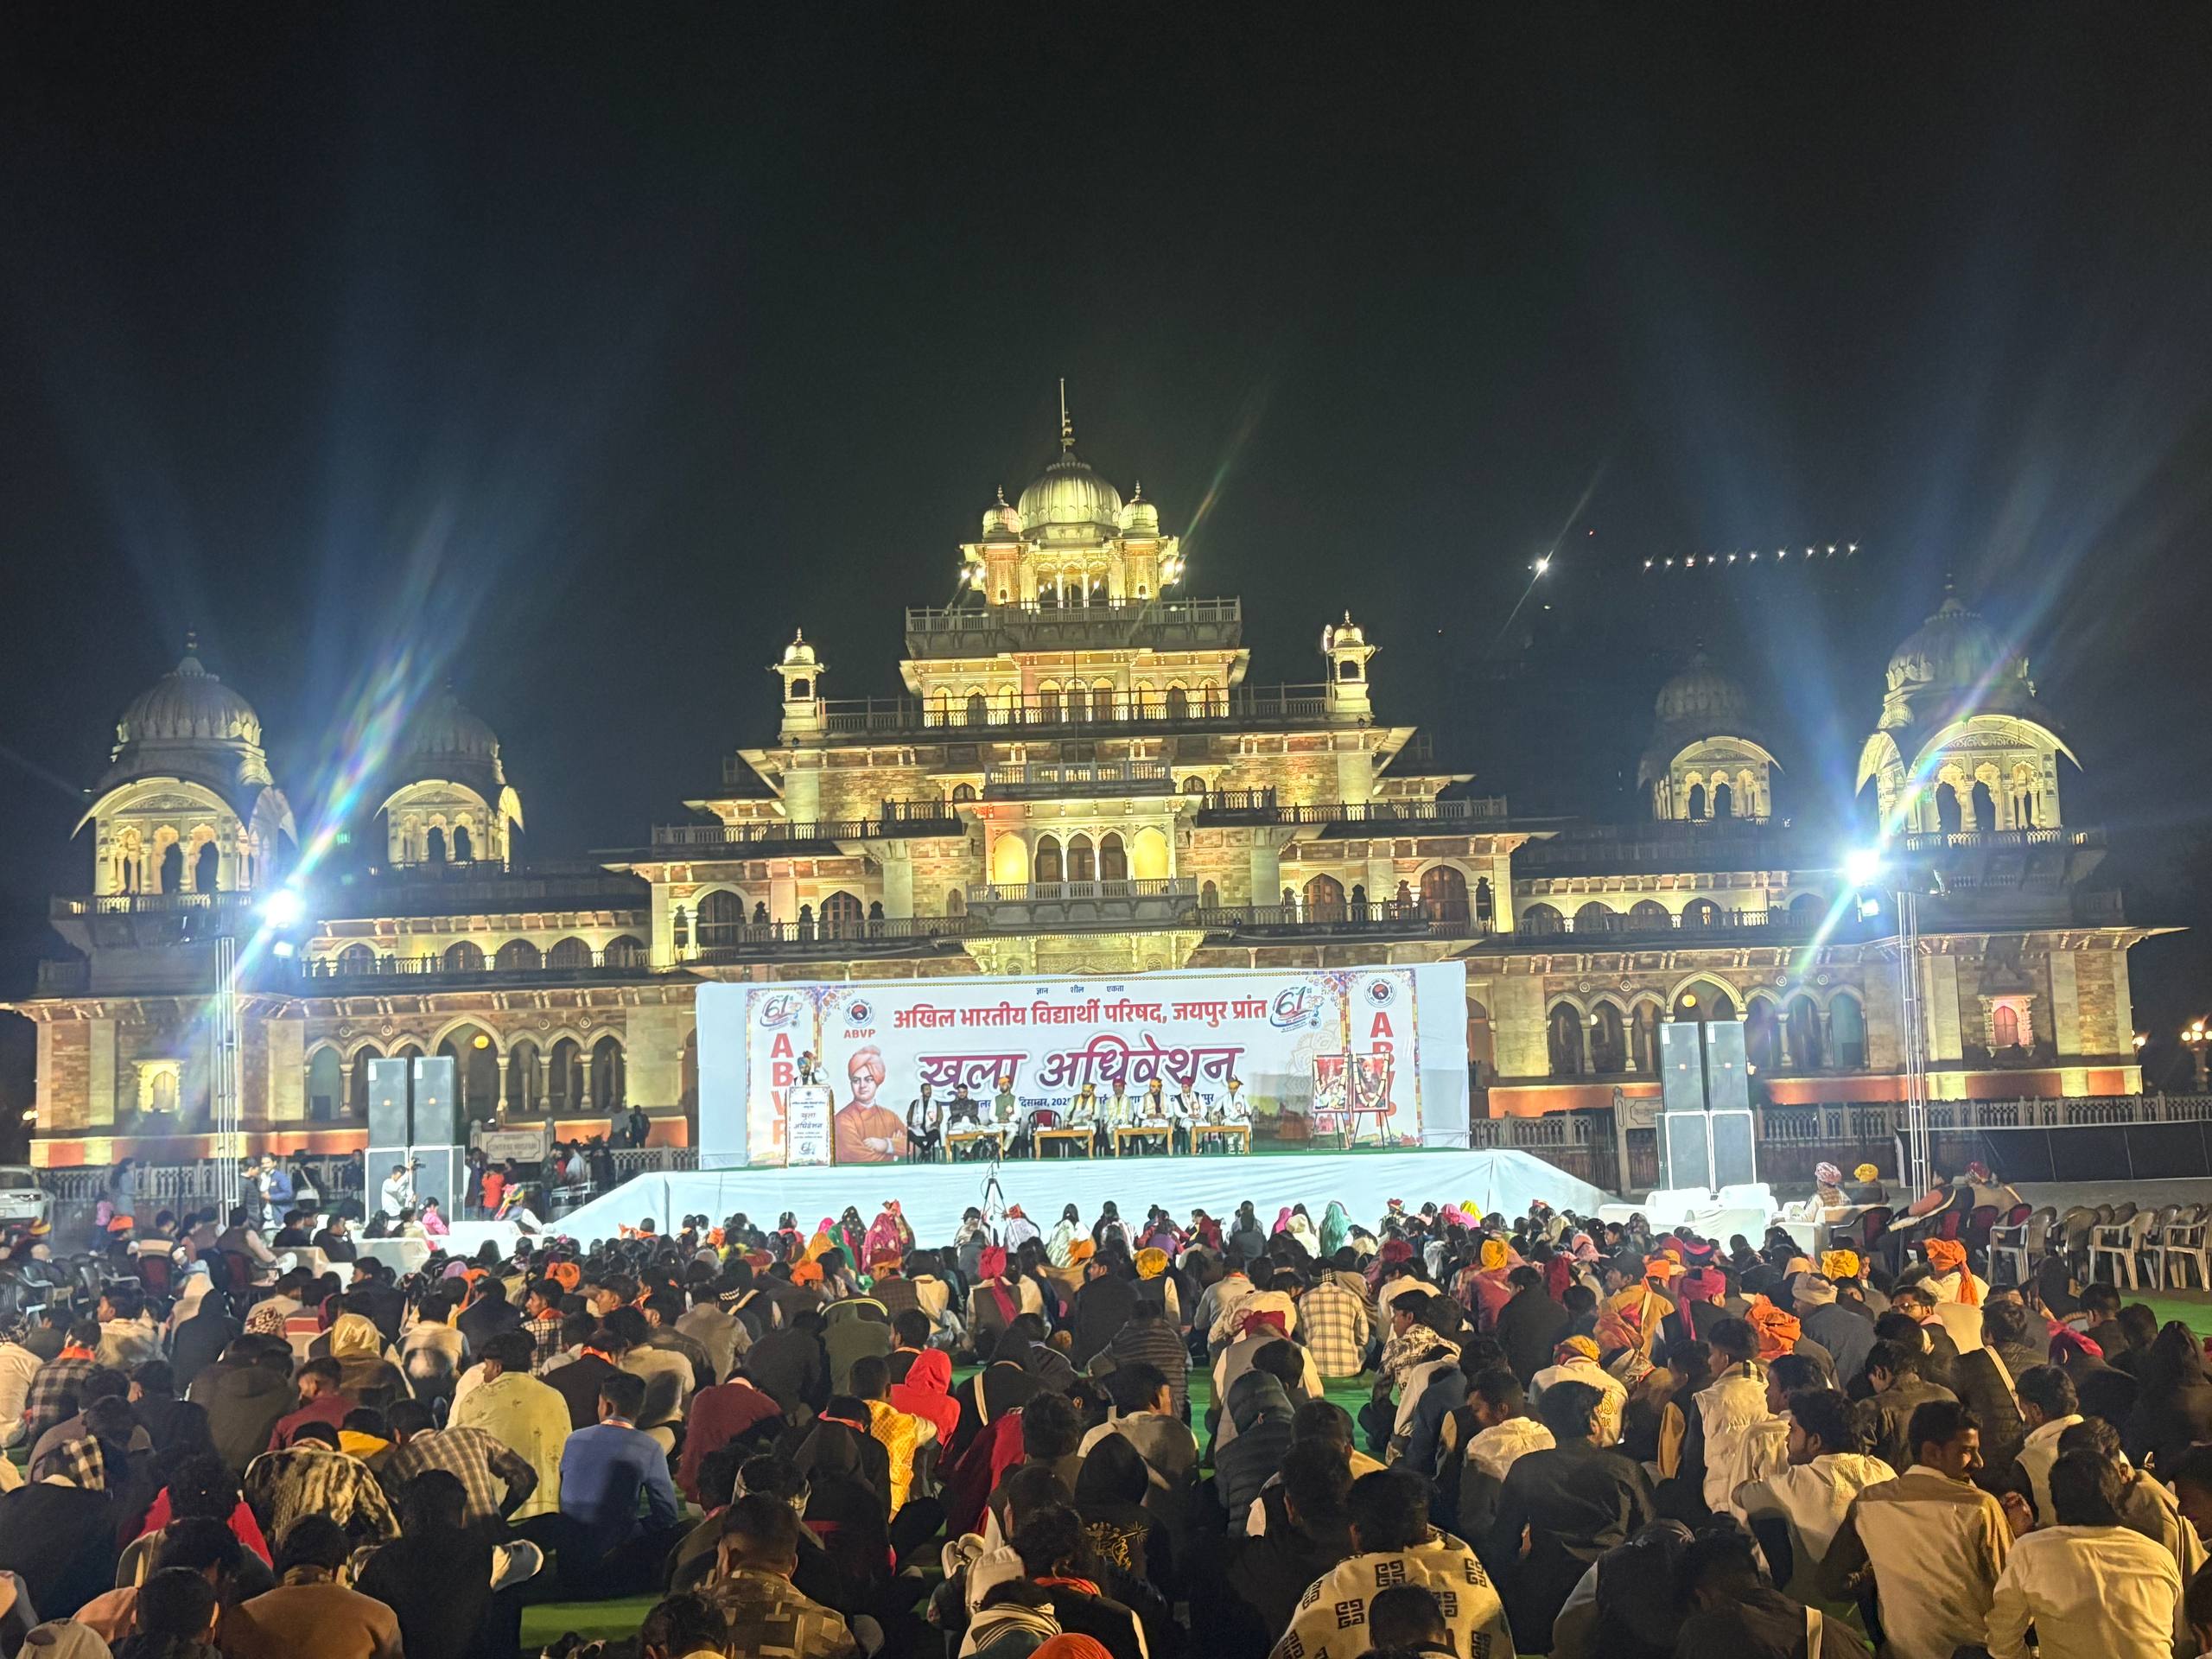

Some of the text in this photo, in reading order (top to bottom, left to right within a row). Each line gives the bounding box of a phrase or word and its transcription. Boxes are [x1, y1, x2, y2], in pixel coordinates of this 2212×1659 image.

[1070, 984, 1084, 994] शील
[893, 1003, 956, 1028] अखिल
[960, 1001, 1027, 1027] भारतीय
[1031, 998, 1101, 1026] विद्यार्थी
[1104, 997, 1167, 1024] परिषद,
[1171, 1001, 1228, 1028] जयपुर
[1231, 995, 1268, 1020] प्रांत
[843, 1029, 876, 1039] ABVP
[918, 1033, 1245, 1096] खुला अधिवेशन
